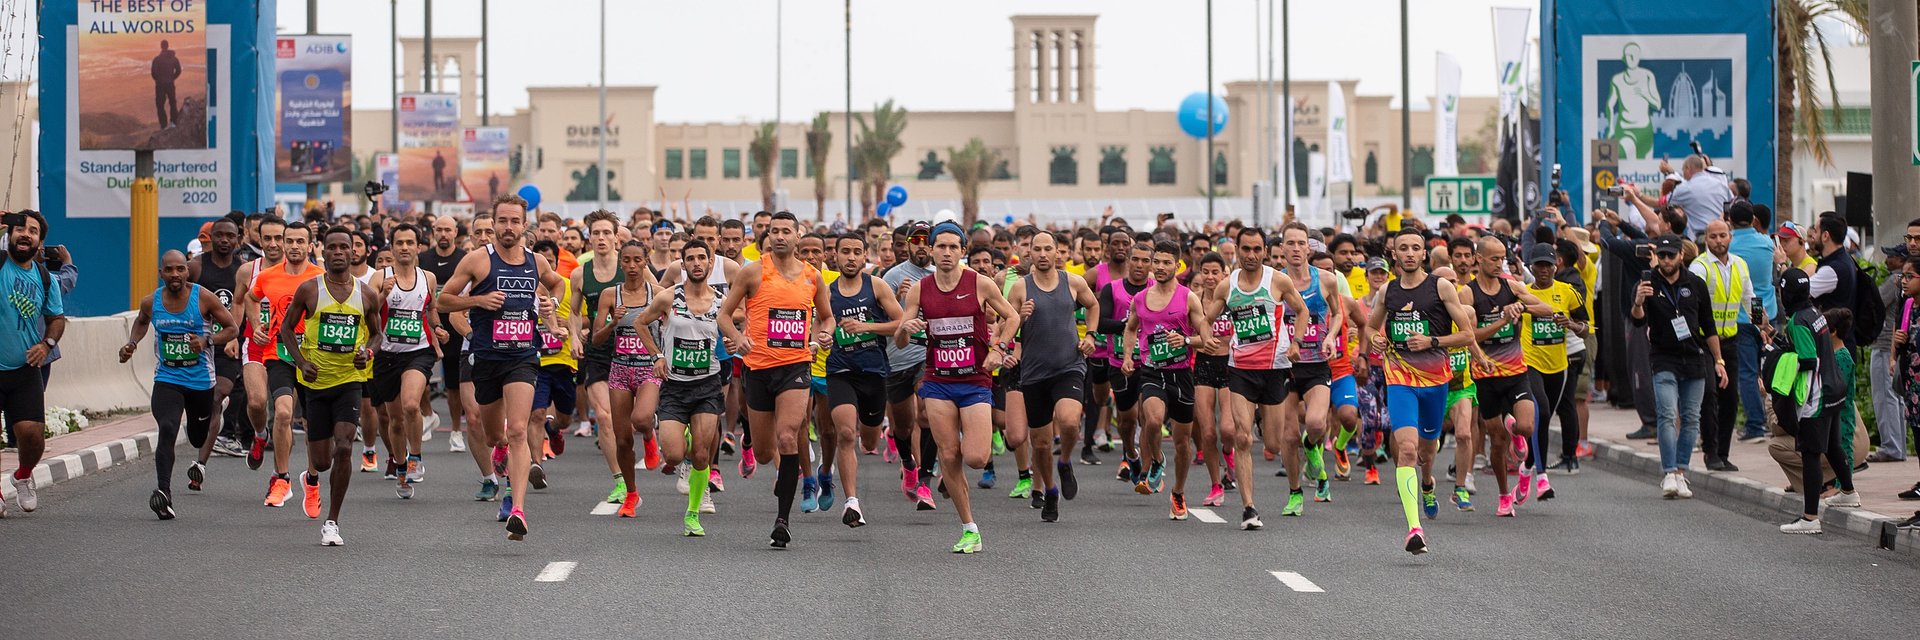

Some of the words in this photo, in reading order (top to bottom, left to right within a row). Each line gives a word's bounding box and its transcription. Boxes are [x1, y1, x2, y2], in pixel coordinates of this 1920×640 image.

[91, 0, 121, 12] THE
[128, 0, 163, 12] BEST
[170, 0, 192, 12] OF
[90, 20, 117, 34] ALL
[122, 19, 194, 34] WORLDS
[566, 138, 618, 147] HOLDNG
[80, 161, 137, 174] Standar
[106, 176, 135, 189] Dub
[1624, 171, 1661, 183] ndard
[182, 191, 217, 204] 2020
[390, 319, 421, 332] 12665
[496, 321, 532, 335] 21500
[770, 320, 805, 335] 10005
[936, 324, 974, 332] SARADAR
[1213, 321, 1232, 332] 030
[1235, 315, 1268, 333] 22474
[1394, 322, 1425, 336] 19818
[323, 325, 356, 339] 13421
[164, 343, 194, 355] 1248
[619, 337, 644, 349] 2150
[675, 350, 708, 363] 21473
[936, 348, 972, 362] 10007
[1449, 354, 1466, 367] 872
